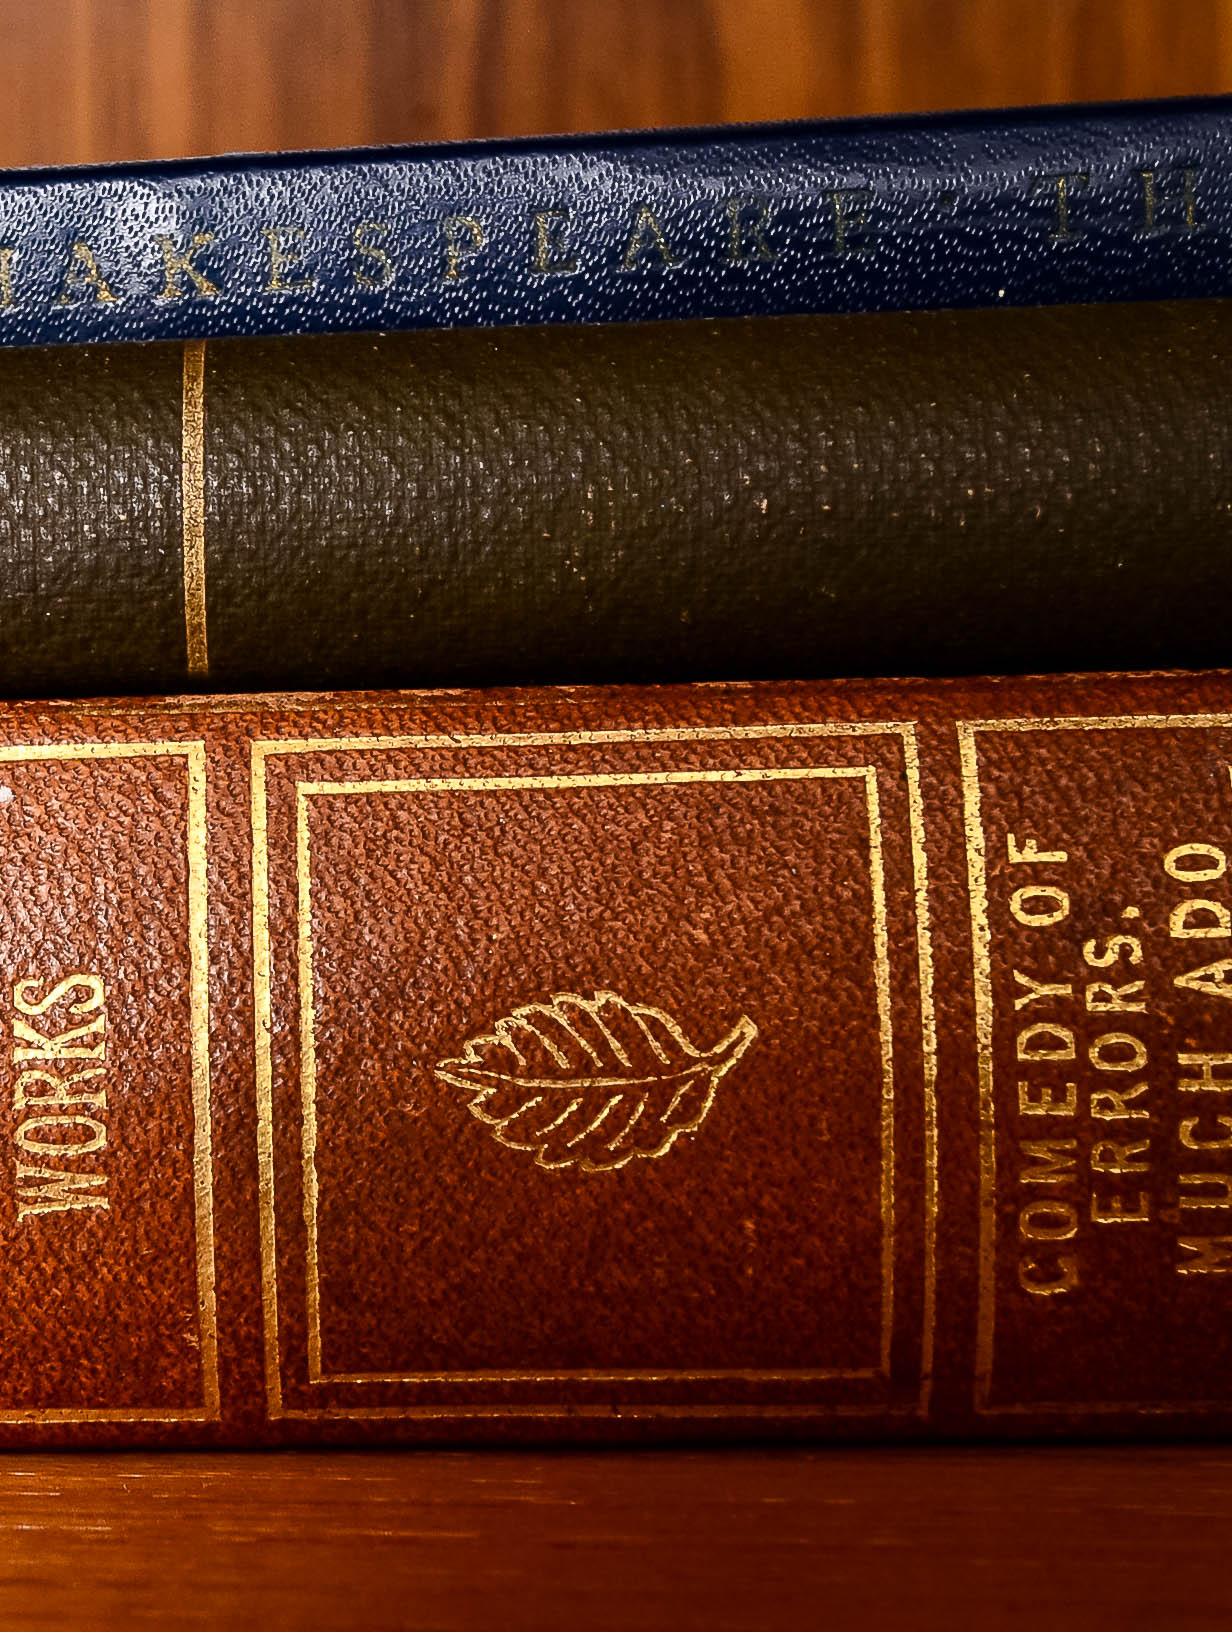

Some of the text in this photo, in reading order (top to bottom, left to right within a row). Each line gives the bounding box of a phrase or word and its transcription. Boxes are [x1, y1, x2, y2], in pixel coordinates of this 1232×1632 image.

[13, 974, 110, 1223] WORKS
[1007, 833, 1078, 1296] COMEDY OF
[1082, 905, 1151, 1224] ERRORS.
[1164, 843, 1232, 1275] MUCH ADO
